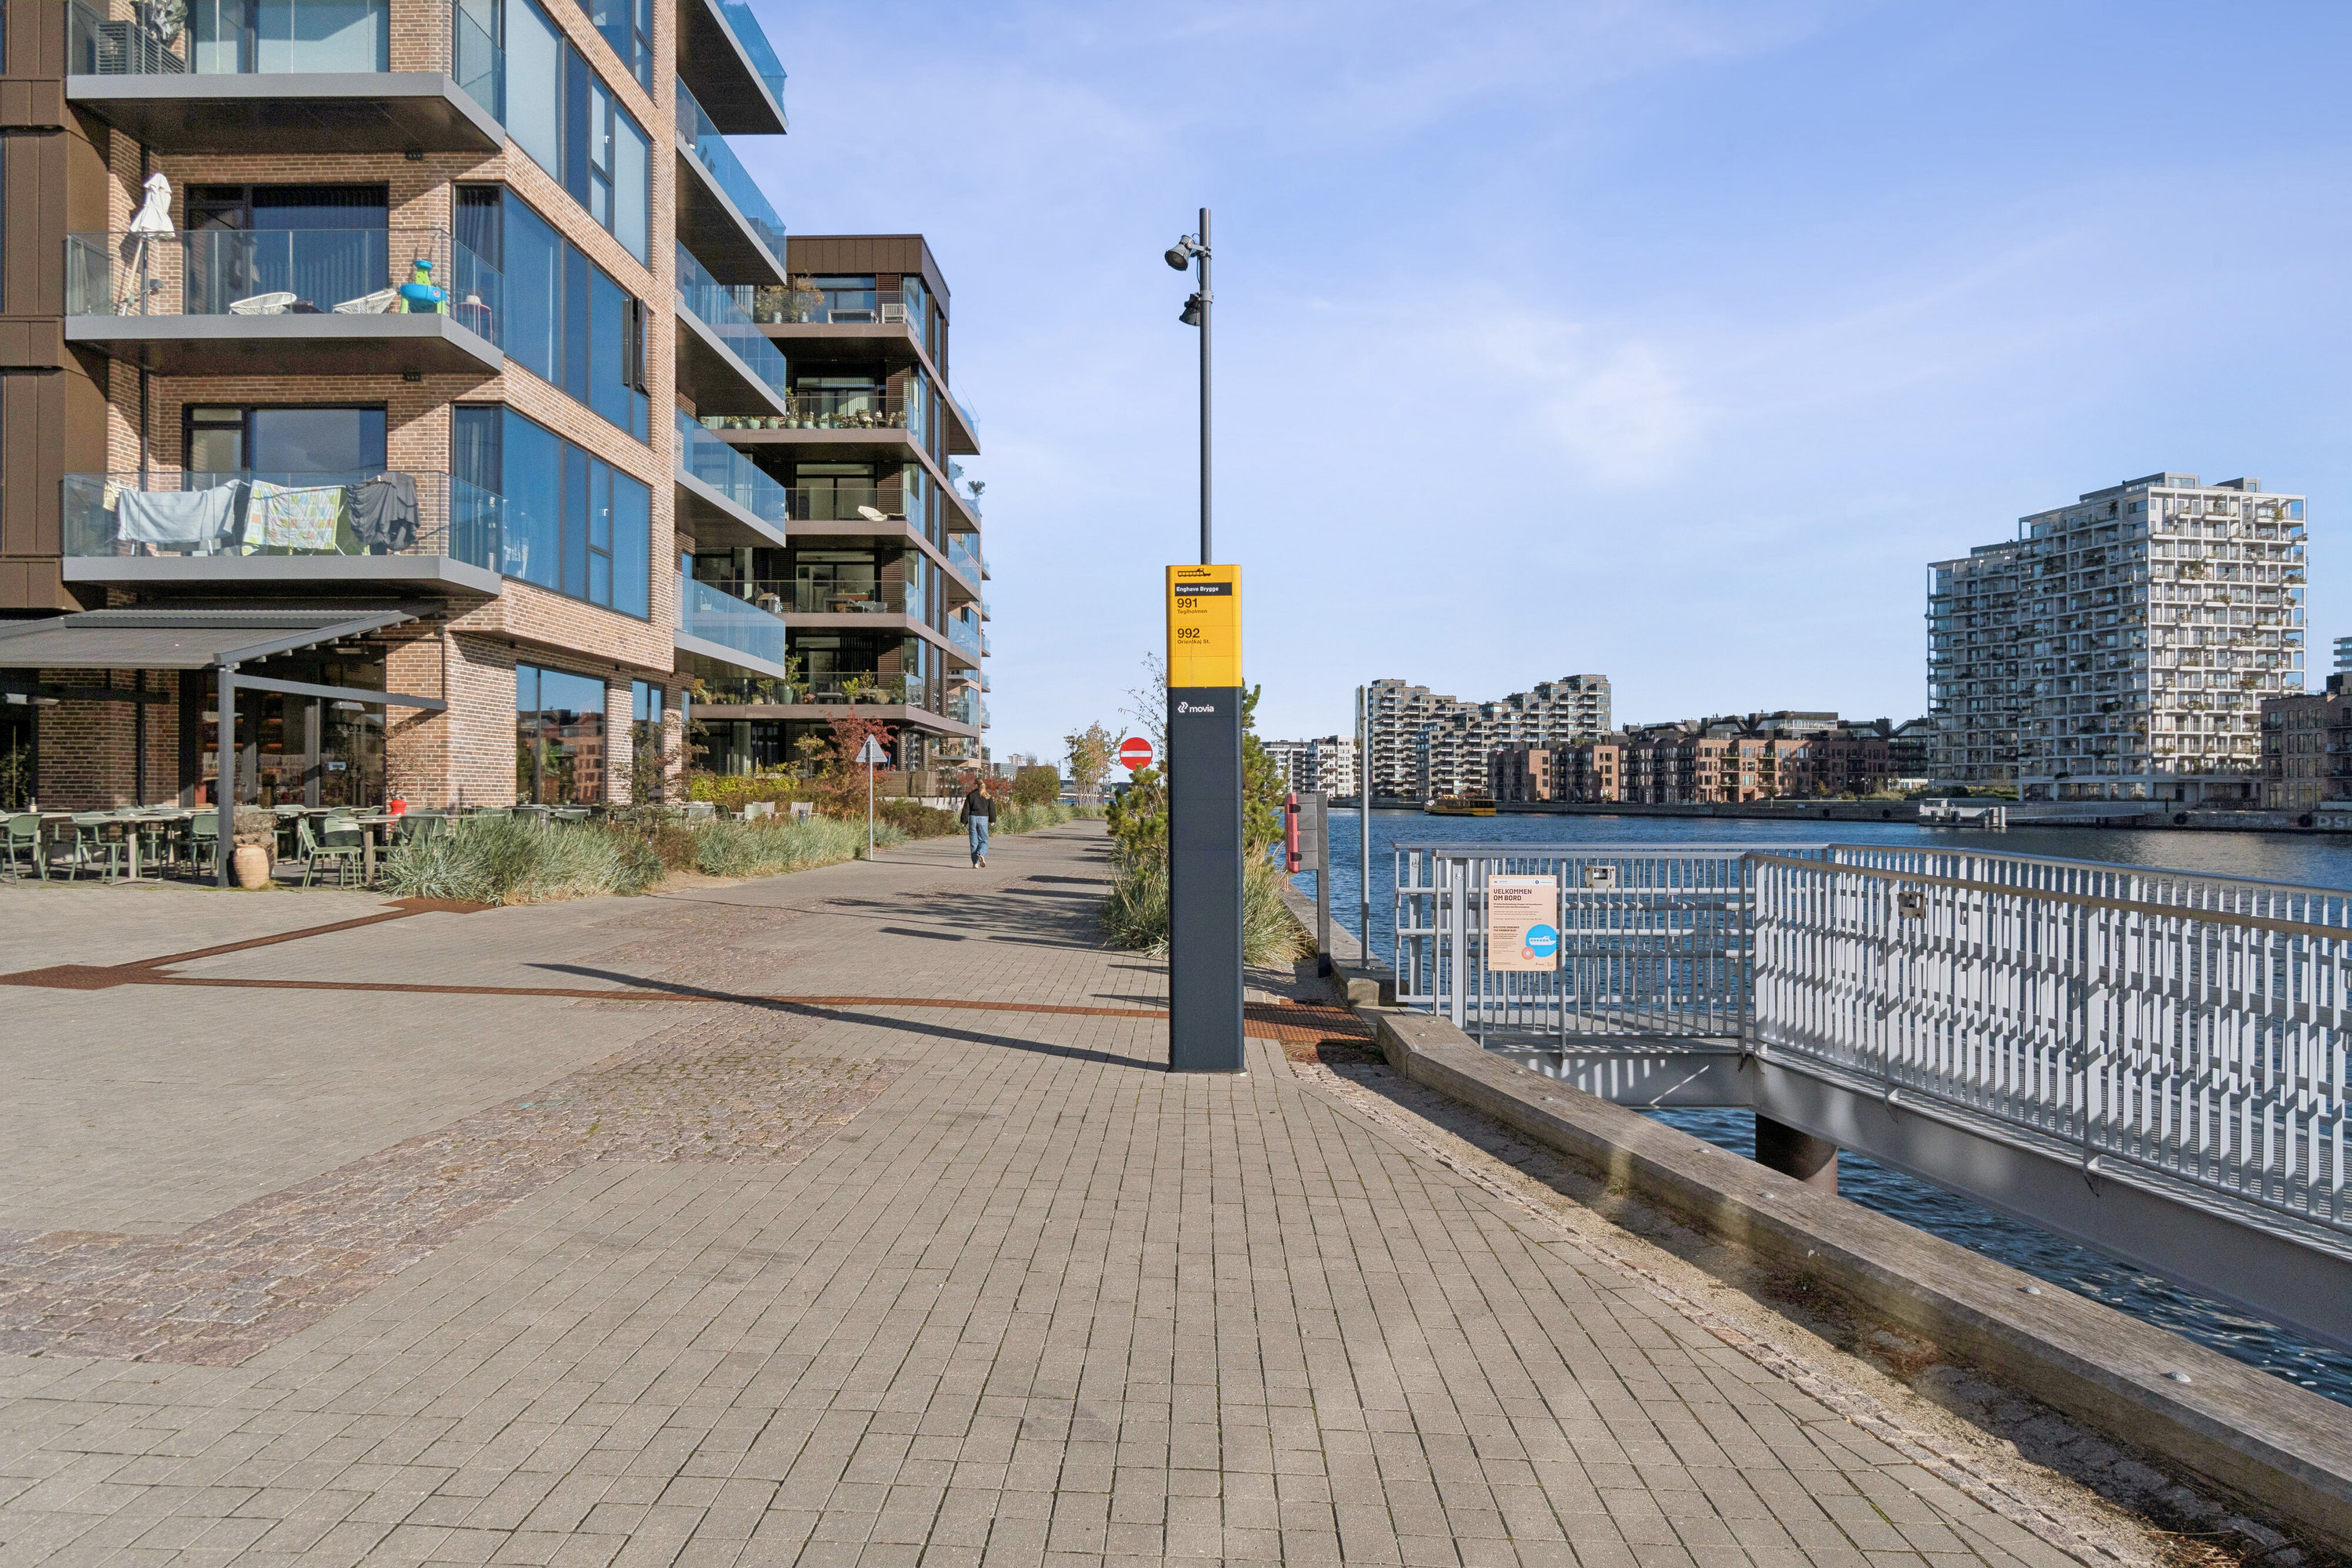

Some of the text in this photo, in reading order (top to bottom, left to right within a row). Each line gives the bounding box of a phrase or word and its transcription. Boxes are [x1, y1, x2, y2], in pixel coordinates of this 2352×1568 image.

[1177, 597, 1197, 608] 991
[1177, 627, 1200, 638] 992
[1189, 704, 1214, 713] movia
